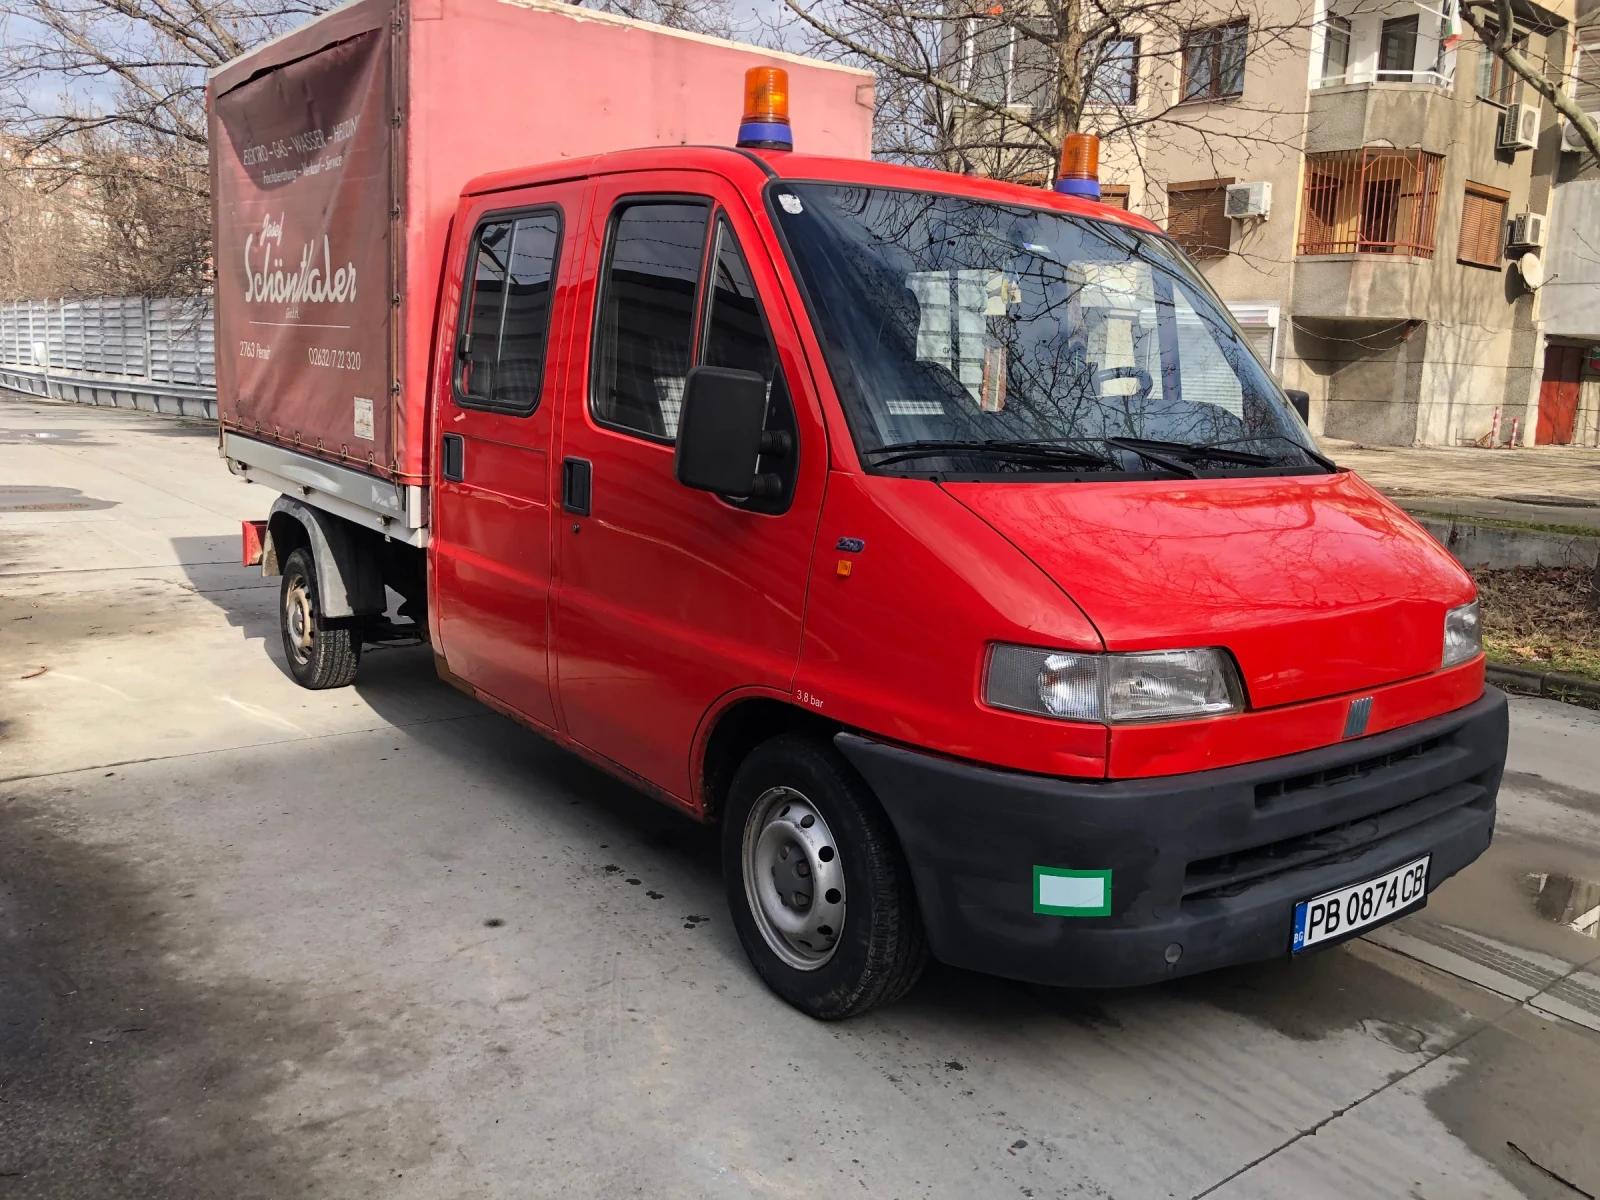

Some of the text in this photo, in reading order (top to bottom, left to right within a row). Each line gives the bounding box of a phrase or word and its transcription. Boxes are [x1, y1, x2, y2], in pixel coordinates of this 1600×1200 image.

[271, 139, 289, 159] GAS
[290, 129, 327, 154] WASSER
[325, 153, 343, 171] Service
[260, 211, 285, 246] Josef
[239, 340, 256, 359] 2763
[346, 350, 361, 371] 320
[810, 694, 824, 708] bar
[1308, 863, 1424, 940] PB 0874 CB
[1293, 931, 1304, 943] BG
